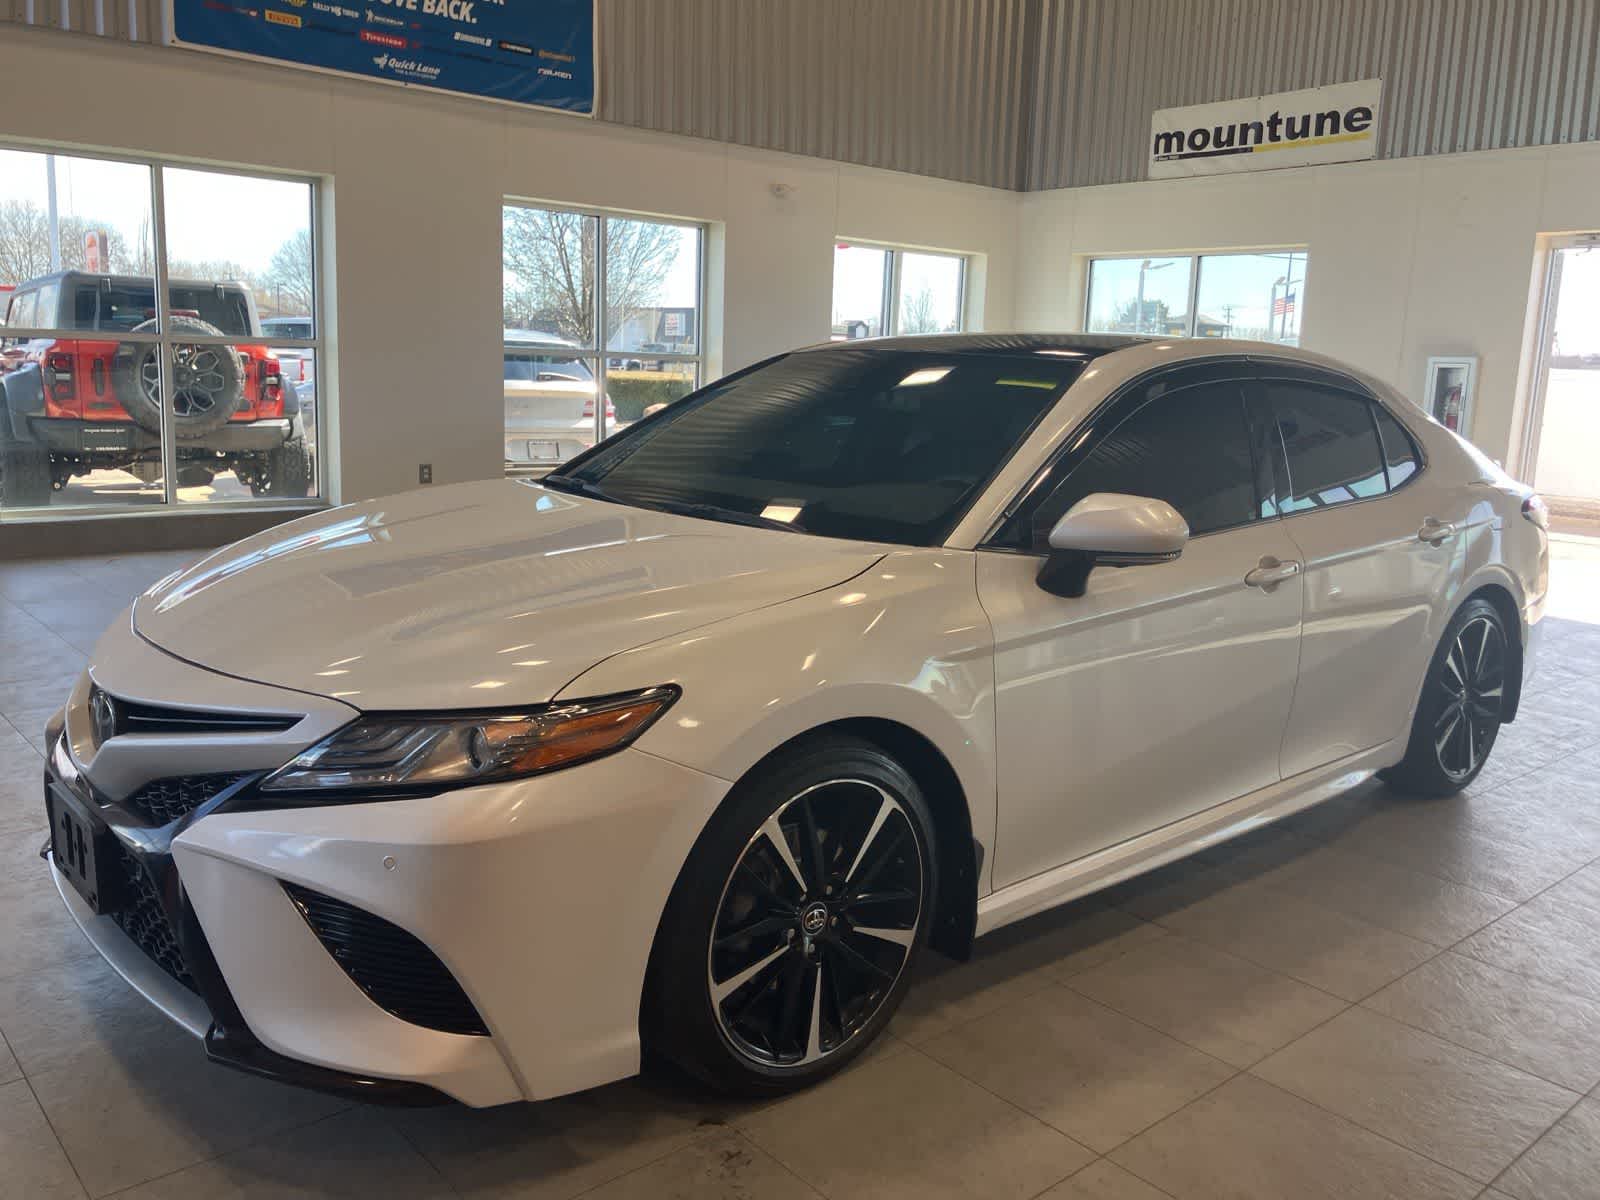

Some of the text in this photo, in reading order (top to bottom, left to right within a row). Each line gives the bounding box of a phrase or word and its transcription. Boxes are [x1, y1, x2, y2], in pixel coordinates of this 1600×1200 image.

[422, 0, 478, 24] BACK.
[388, 58, 416, 71] Quick
[416, 62, 441, 76] Lane
[1153, 106, 1373, 155] mountune
